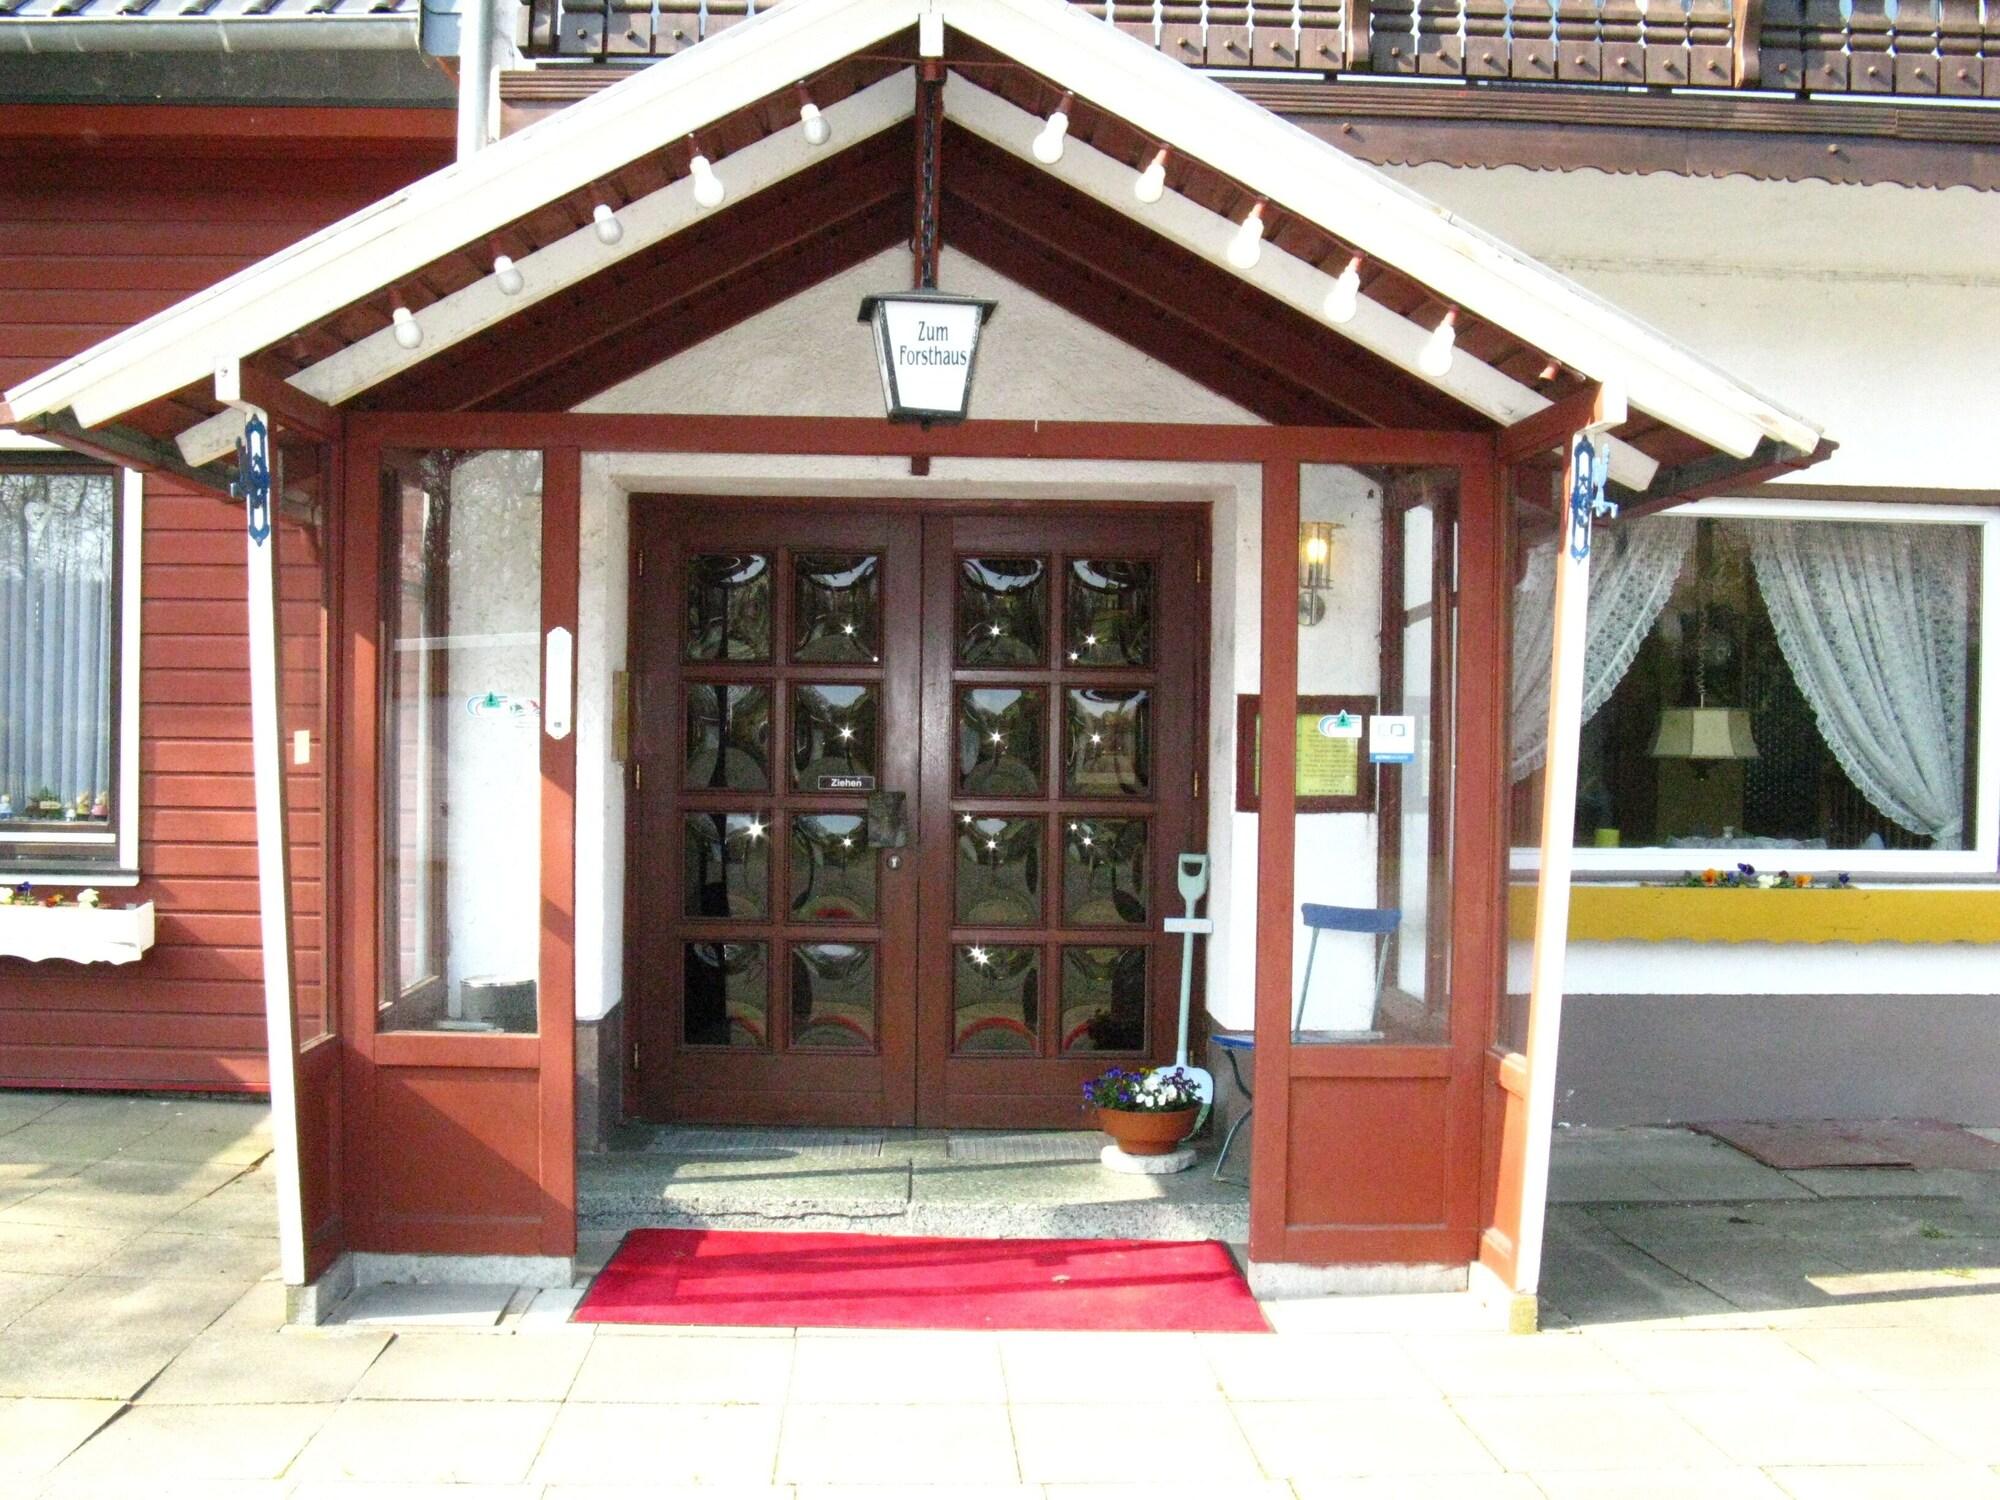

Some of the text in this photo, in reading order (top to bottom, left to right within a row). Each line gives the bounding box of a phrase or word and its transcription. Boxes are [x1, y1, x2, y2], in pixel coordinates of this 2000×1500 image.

[918, 320, 949, 342] Zum
[899, 345, 967, 366] Forsthaus
[831, 778, 862, 787] Ziehen
